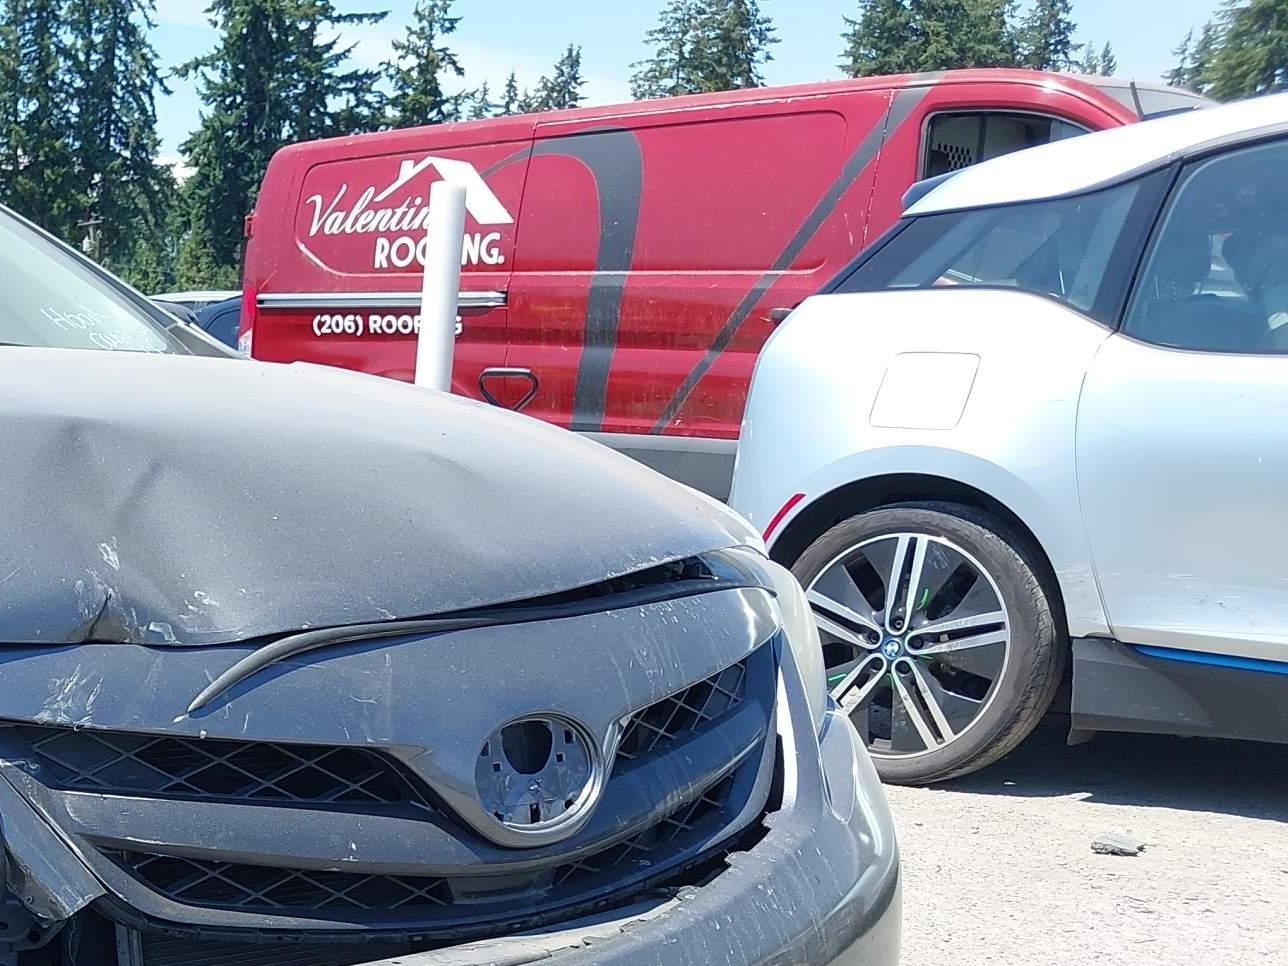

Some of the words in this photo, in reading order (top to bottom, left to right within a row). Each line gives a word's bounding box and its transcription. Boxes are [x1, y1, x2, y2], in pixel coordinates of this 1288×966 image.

[306, 184, 431, 236] Valentin
[374, 232, 505, 269] RONG.
[312, 314, 364, 336] (206)
